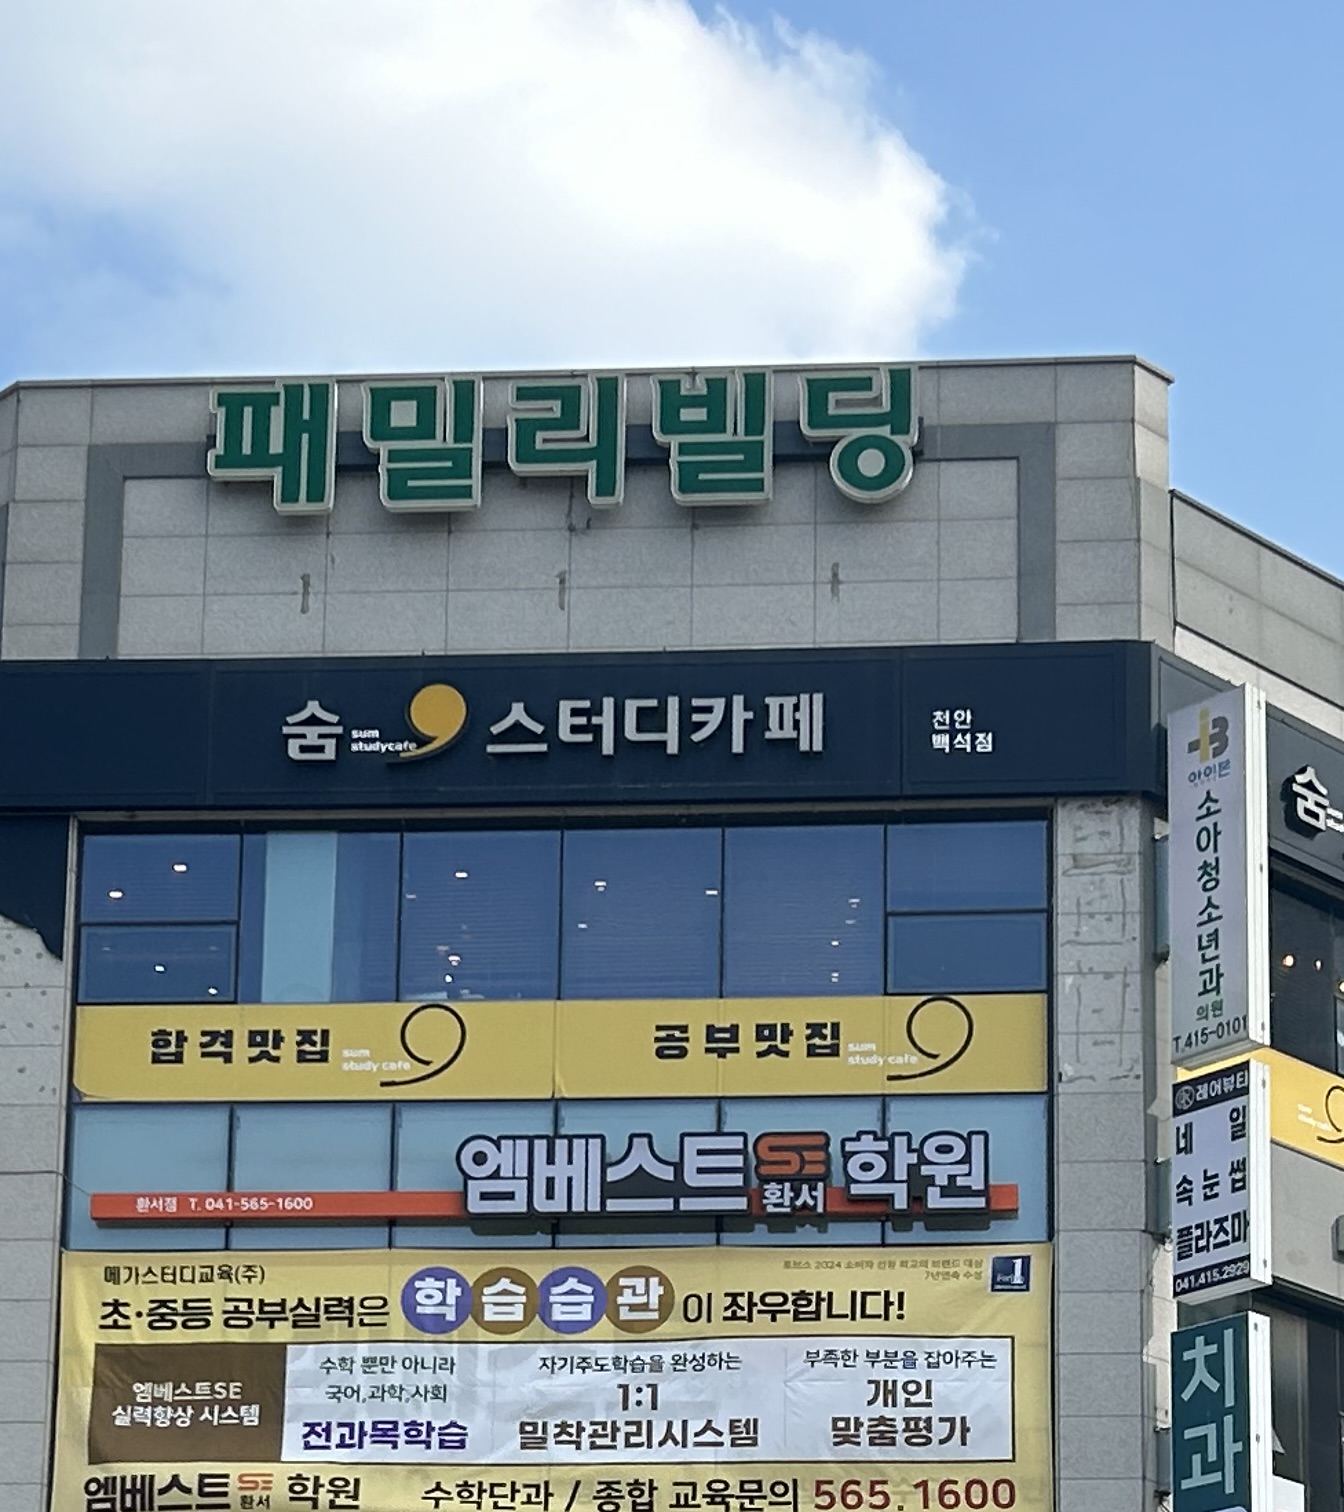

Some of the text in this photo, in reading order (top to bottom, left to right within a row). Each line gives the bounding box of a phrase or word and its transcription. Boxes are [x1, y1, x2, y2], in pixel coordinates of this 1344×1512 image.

[207, 366, 920, 516] 패밀리빌딩
[282, 700, 344, 762] 숨
[485, 692, 825, 756] 스터디카페
[932, 709, 973, 730] 천안
[931, 732, 995, 754] 백석점
[1188, 759, 1232, 783] 아이본
[1292, 766, 1330, 831] 숨
[1195, 789, 1224, 997] 소아청소년과
[150, 1027, 331, 1065] 합격맛집
[654, 1021, 843, 1060] 공부맛집
[1196, 1070, 1249, 1101] 레어뷰티
[457, 1133, 749, 1215] 엠베스트
[840, 1129, 991, 1212] 학원
[1176, 1157, 1247, 1206] 속눈썹
[204, 1197, 314, 1211] 041-565-1600
[761, 1181, 826, 1214] 환서
[1176, 1209, 1250, 1262] 플라즈마
[103, 1265, 266, 1286] 메가스터디교육(주)
[1175, 1261, 1250, 1293] 041.415.2929
[98, 1297, 213, 1331] 초·중등
[222, 1295, 391, 1330] 공부실력은
[681, 1291, 713, 1323] 이
[722, 1290, 907, 1323] 좌우합니다!
[319, 1356, 456, 1375] 수학 뿐만 아니라
[538, 1353, 742, 1375] 자기주도학습을 완성하는
[804, 1350, 998, 1370] 부족한 부분을 잡아주는
[132, 1382, 243, 1402] 엠베스트SE
[615, 1382, 660, 1411] 1:1
[867, 1378, 934, 1409] 개인
[111, 1405, 260, 1428] 실력향상 시스템
[1180, 1327, 1242, 1494] 치과
[301, 1417, 971, 1452] 전과목학습 밀착관리시스템 맞춤평가
[287, 1473, 362, 1511] 학원
[420, 1479, 554, 1512] 수학단과
[592, 1480, 659, 1512] 종합
[668, 1478, 800, 1512] 교육문의
